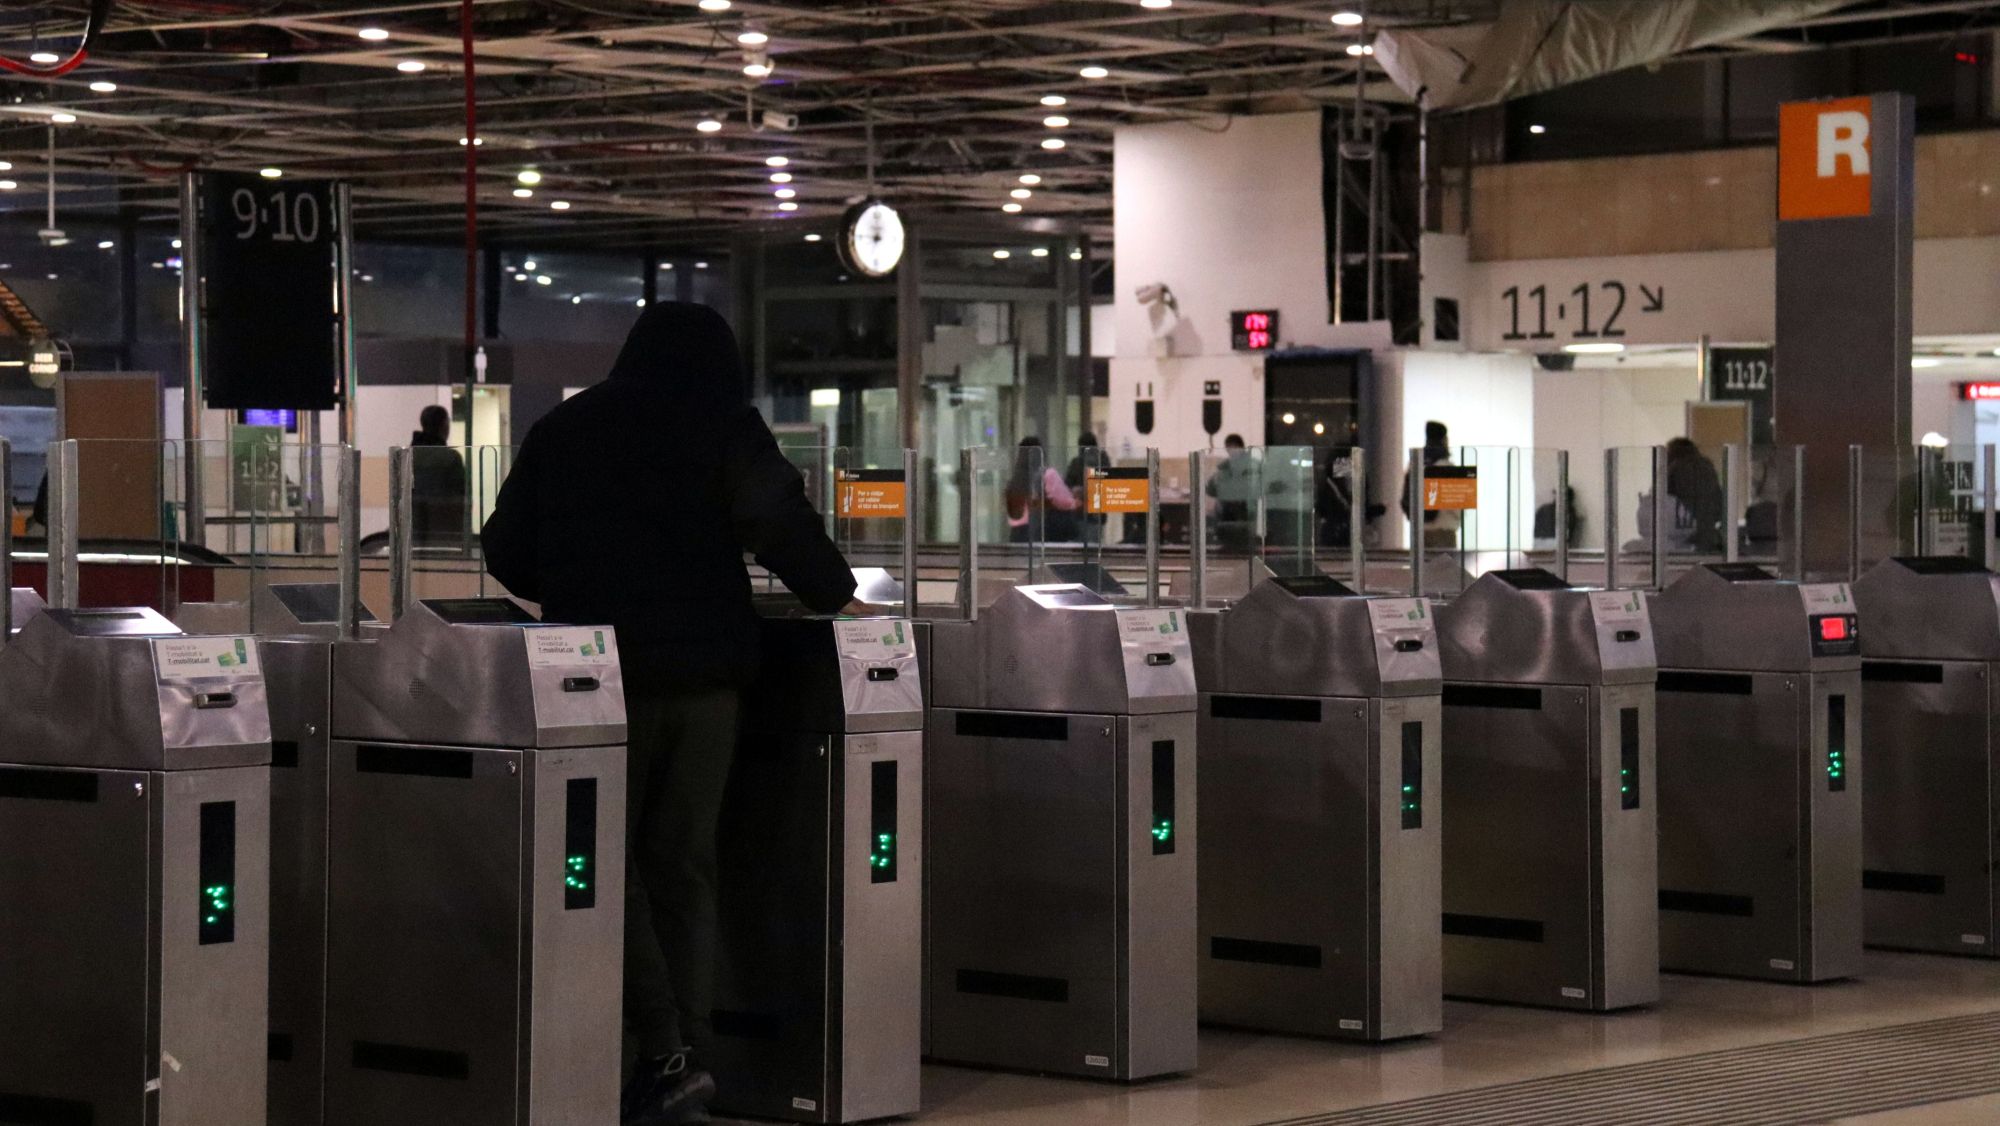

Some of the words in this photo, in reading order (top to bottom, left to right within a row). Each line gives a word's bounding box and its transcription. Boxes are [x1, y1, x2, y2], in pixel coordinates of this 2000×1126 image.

[1818, 111, 1871, 177] R
[1502, 281, 1625, 340] 11·12
[1725, 361, 1768, 390] 11·12
